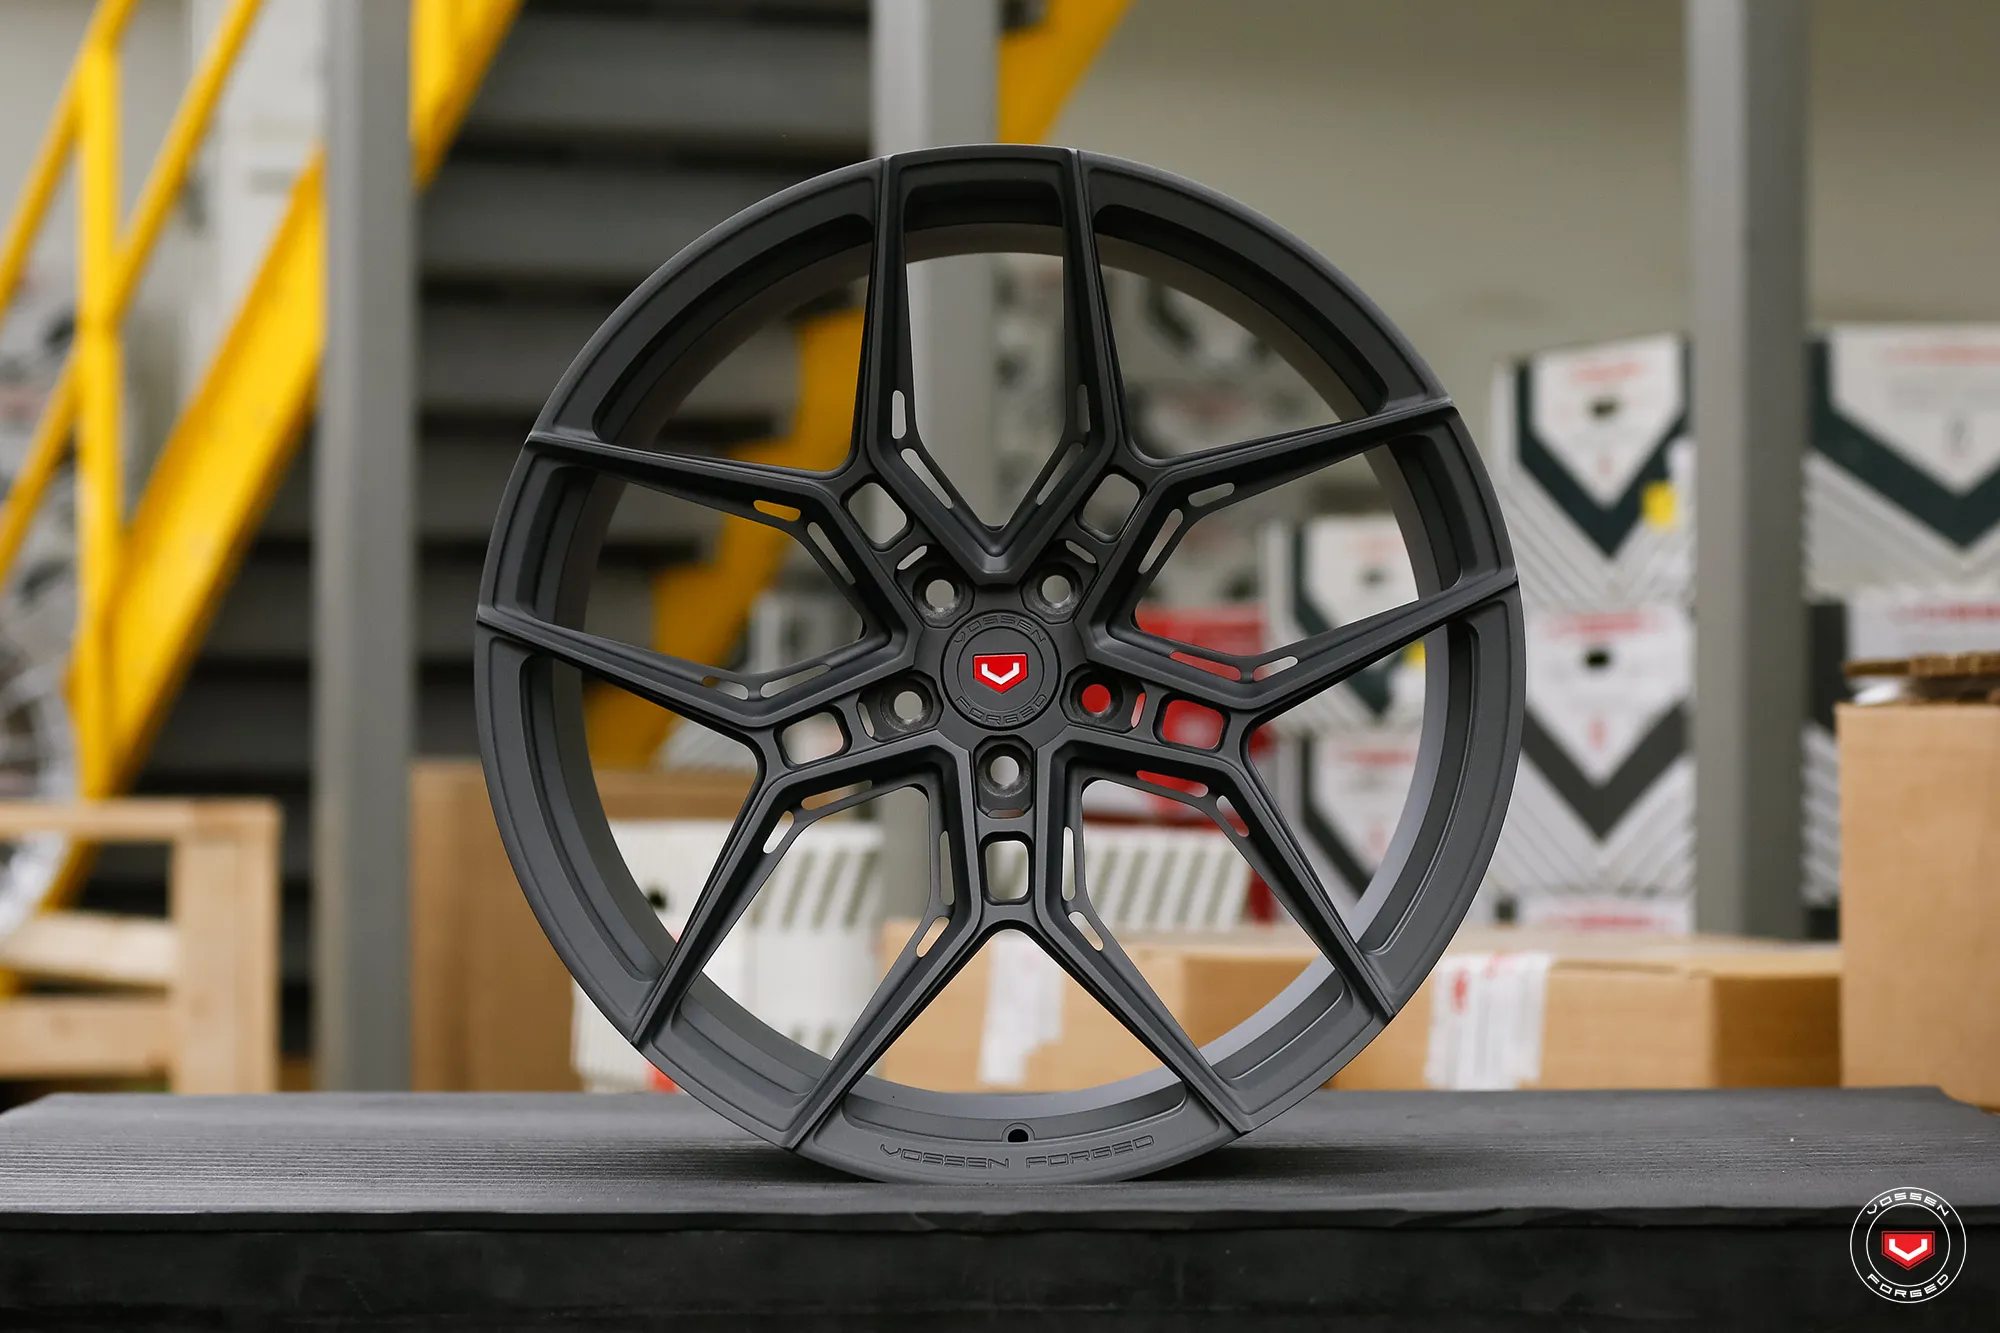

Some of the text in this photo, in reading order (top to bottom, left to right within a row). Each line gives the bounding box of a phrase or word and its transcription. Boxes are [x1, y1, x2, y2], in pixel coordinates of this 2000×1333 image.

[954, 615, 1046, 644] VOSSEN
[955, 694, 1047, 725] FORGED
[880, 1135, 1155, 1169] VOSSEN FORGED
